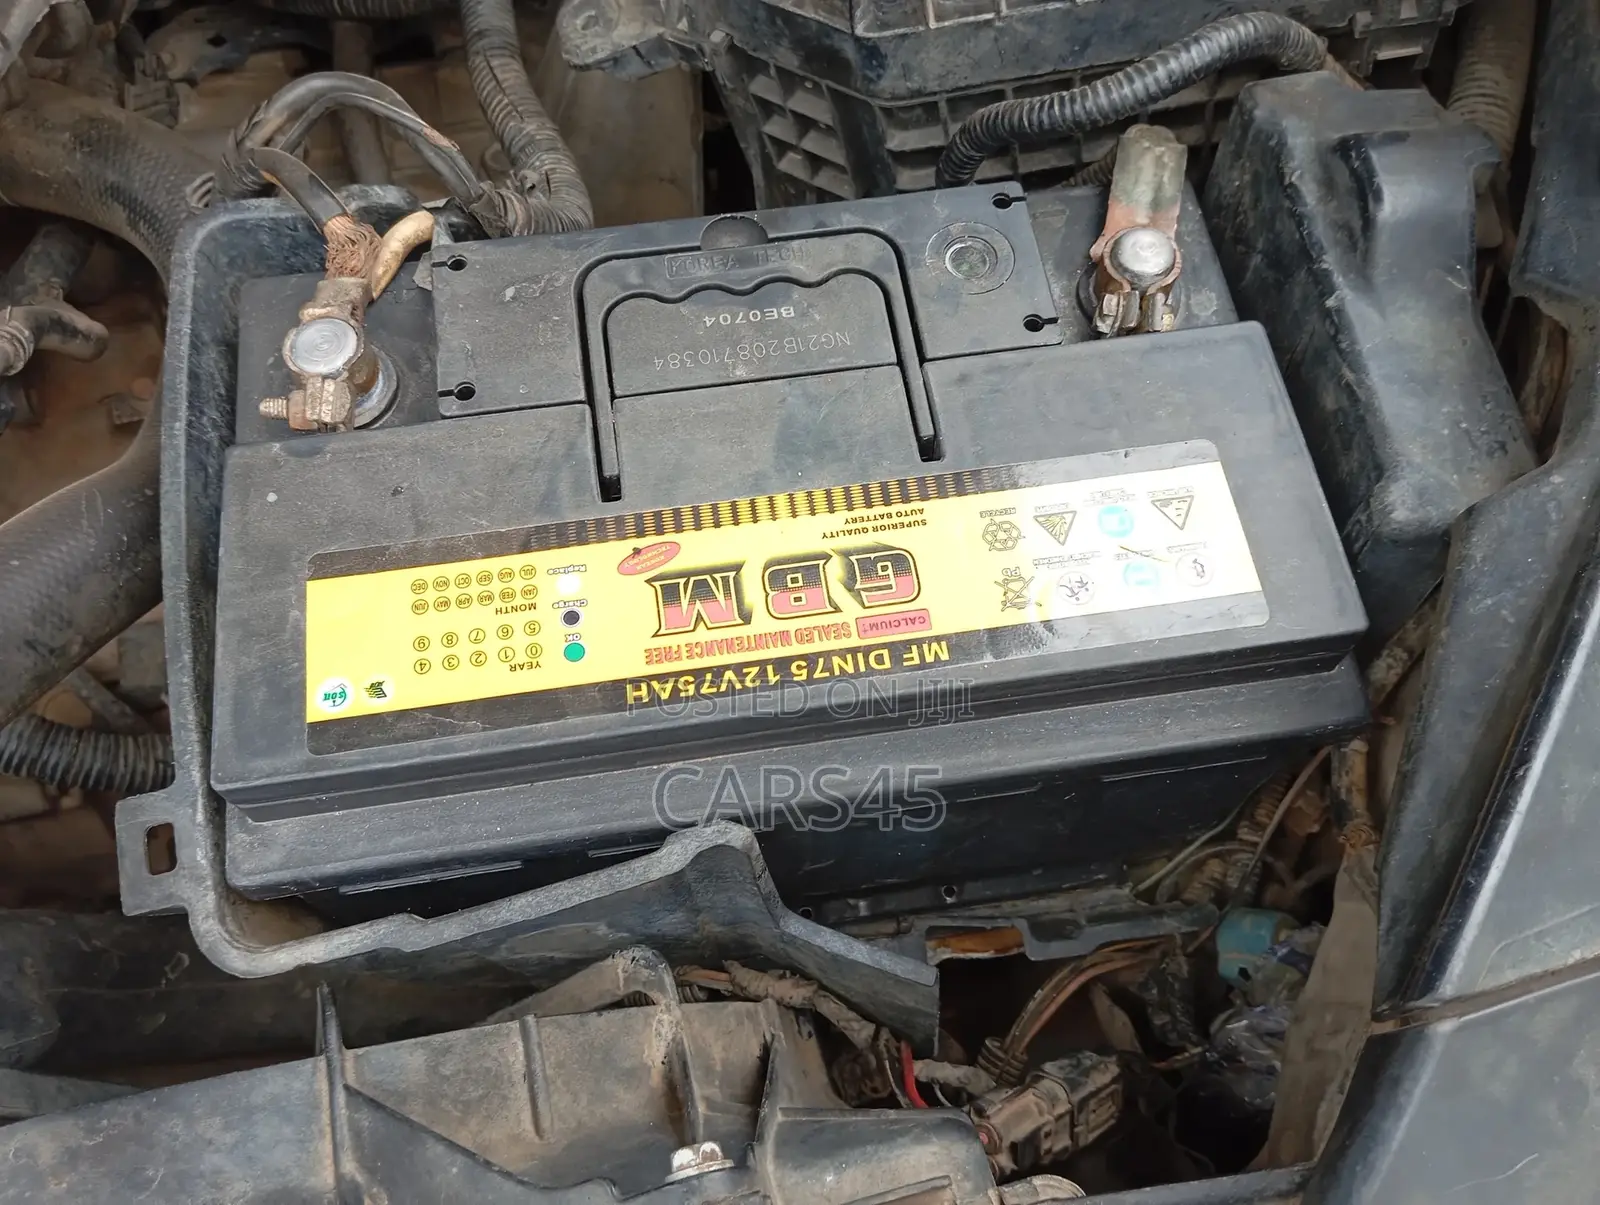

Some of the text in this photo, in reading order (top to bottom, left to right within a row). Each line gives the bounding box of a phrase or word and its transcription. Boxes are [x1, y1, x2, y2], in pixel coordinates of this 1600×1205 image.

[669, 254, 740, 276] KOREA
[703, 305, 795, 328] BE0704
[844, 507, 925, 525] AUTO BATTERY
[979, 506, 1017, 518] RECYCLE
[821, 518, 927, 540] SUPERIOR QUALITY
[547, 564, 587, 576] Replace
[1001, 566, 1021, 578] Pb
[645, 548, 921, 638] GBM
[495, 602, 537, 616] MONTH
[552, 599, 588, 610] Charge
[564, 633, 582, 643] OK
[643, 621, 853, 666] SEALED MAINTENANCE FREE
[509, 660, 542, 672] YEAR
[625, 641, 950, 705] MF DIN75 12V75AH
